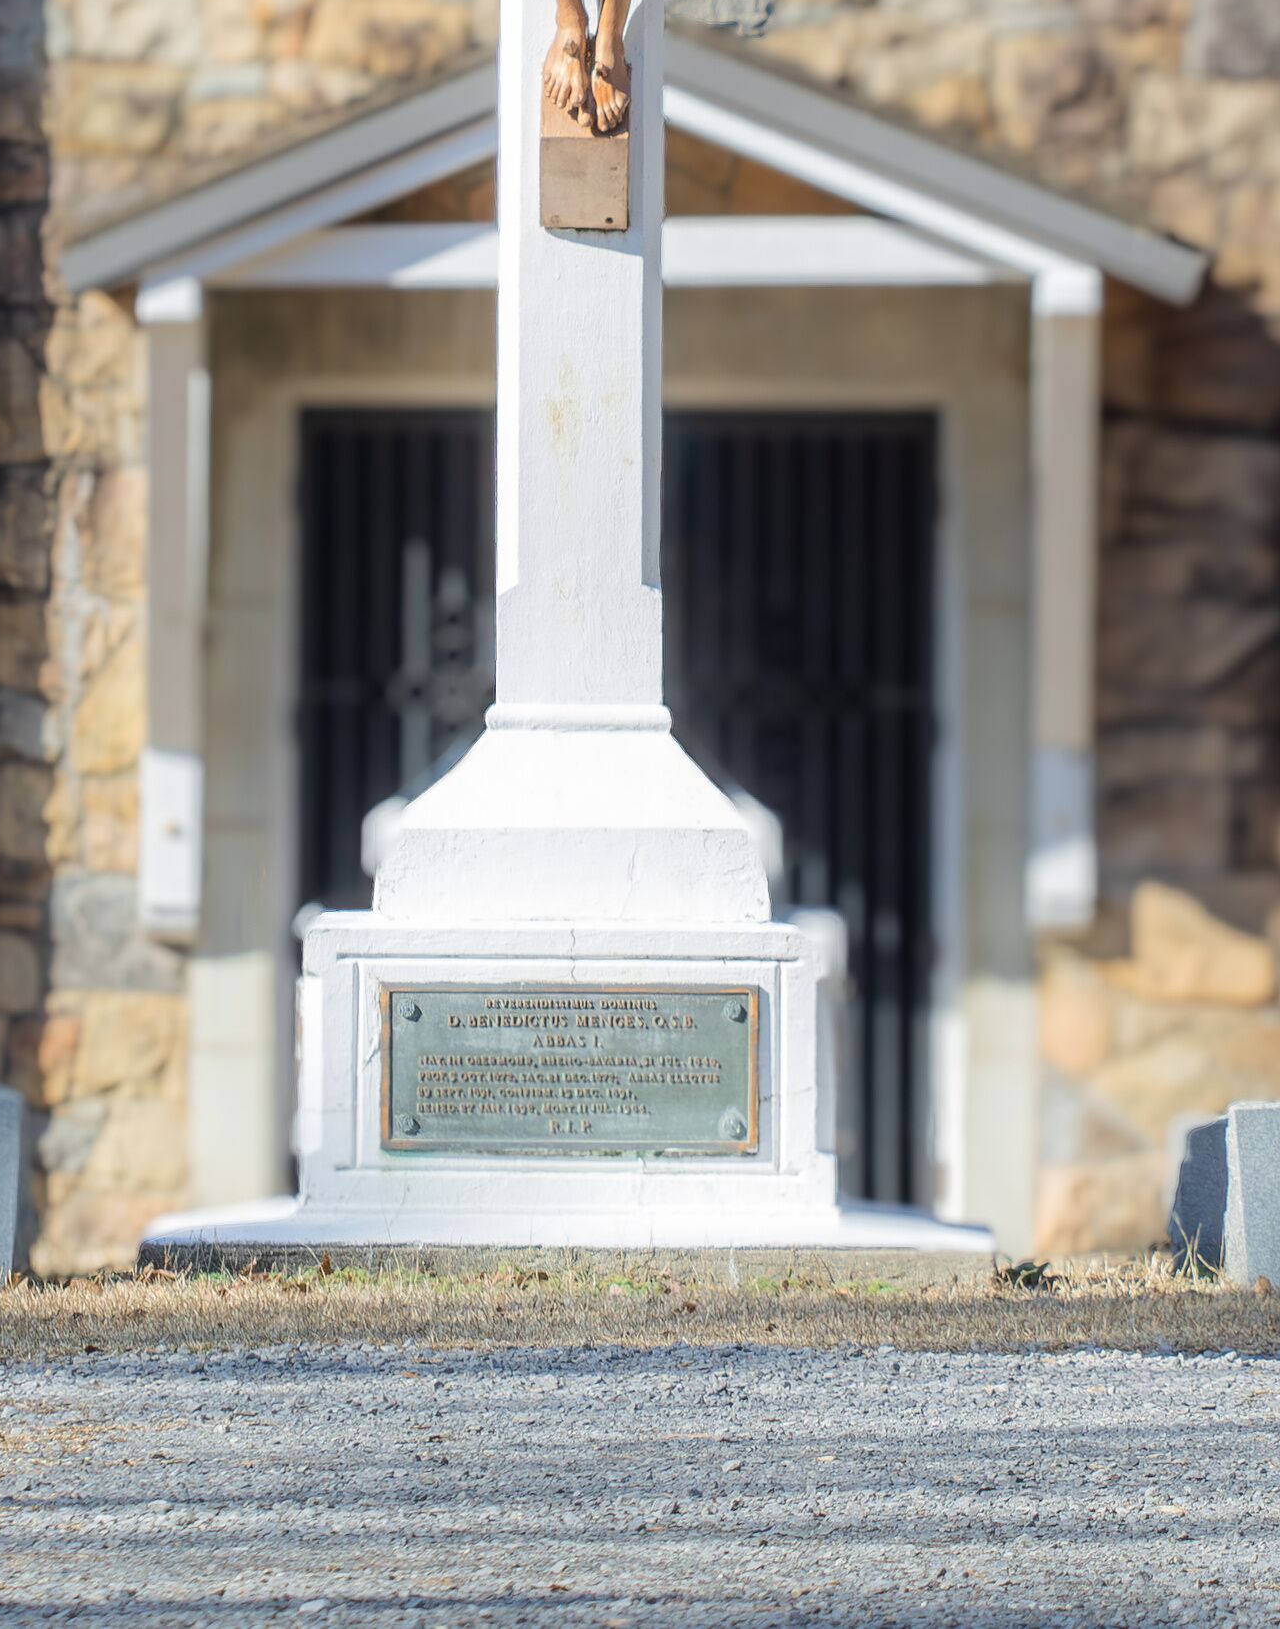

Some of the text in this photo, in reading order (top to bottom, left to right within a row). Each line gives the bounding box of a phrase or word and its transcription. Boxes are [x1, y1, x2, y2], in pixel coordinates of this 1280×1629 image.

[483, 999, 658, 1011] REVERENDISSIMUS DOMINUS
[467, 1014, 569, 1028] BENEDICTUS
[576, 1014, 649, 1030] MENGES,
[652, 1014, 698, 1029] O.S.B.
[532, 1033, 587, 1048] ABBAS
